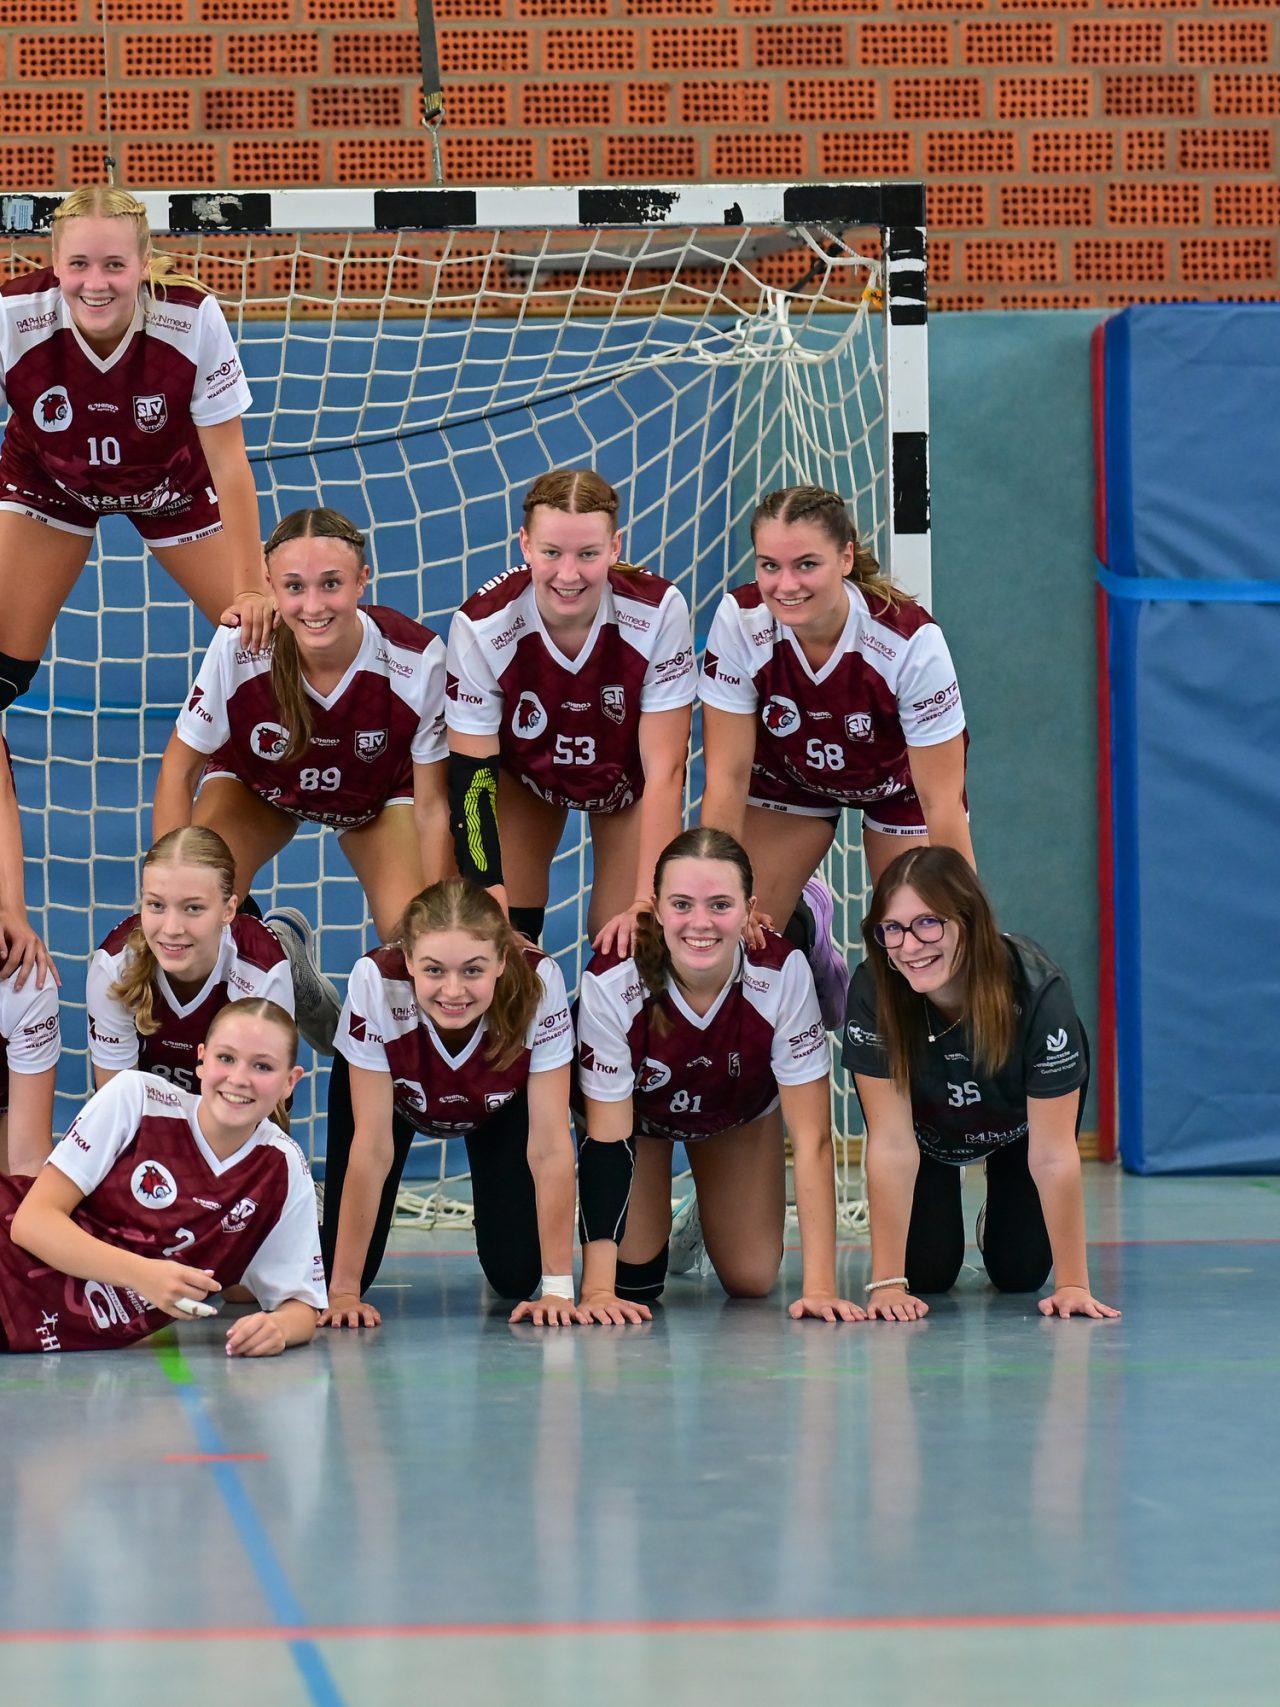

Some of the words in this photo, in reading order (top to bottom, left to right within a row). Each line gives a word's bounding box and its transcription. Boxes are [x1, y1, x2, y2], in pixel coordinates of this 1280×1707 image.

[87, 436, 121, 466] 10
[718, 671, 741, 686] TKM
[459, 692, 483, 706] TKM
[912, 680, 958, 712] SPOTZ
[553, 733, 596, 766] 53
[806, 738, 845, 771] 58
[299, 766, 342, 792] 89
[538, 1007, 568, 1029] OTZ
[97, 1034, 120, 1045] TKM
[595, 1061, 618, 1075] TKM
[670, 1089, 702, 1113] 81
[947, 1081, 982, 1107] 35
[72, 1129, 91, 1153] TKM
[163, 1227, 196, 1257] 2
